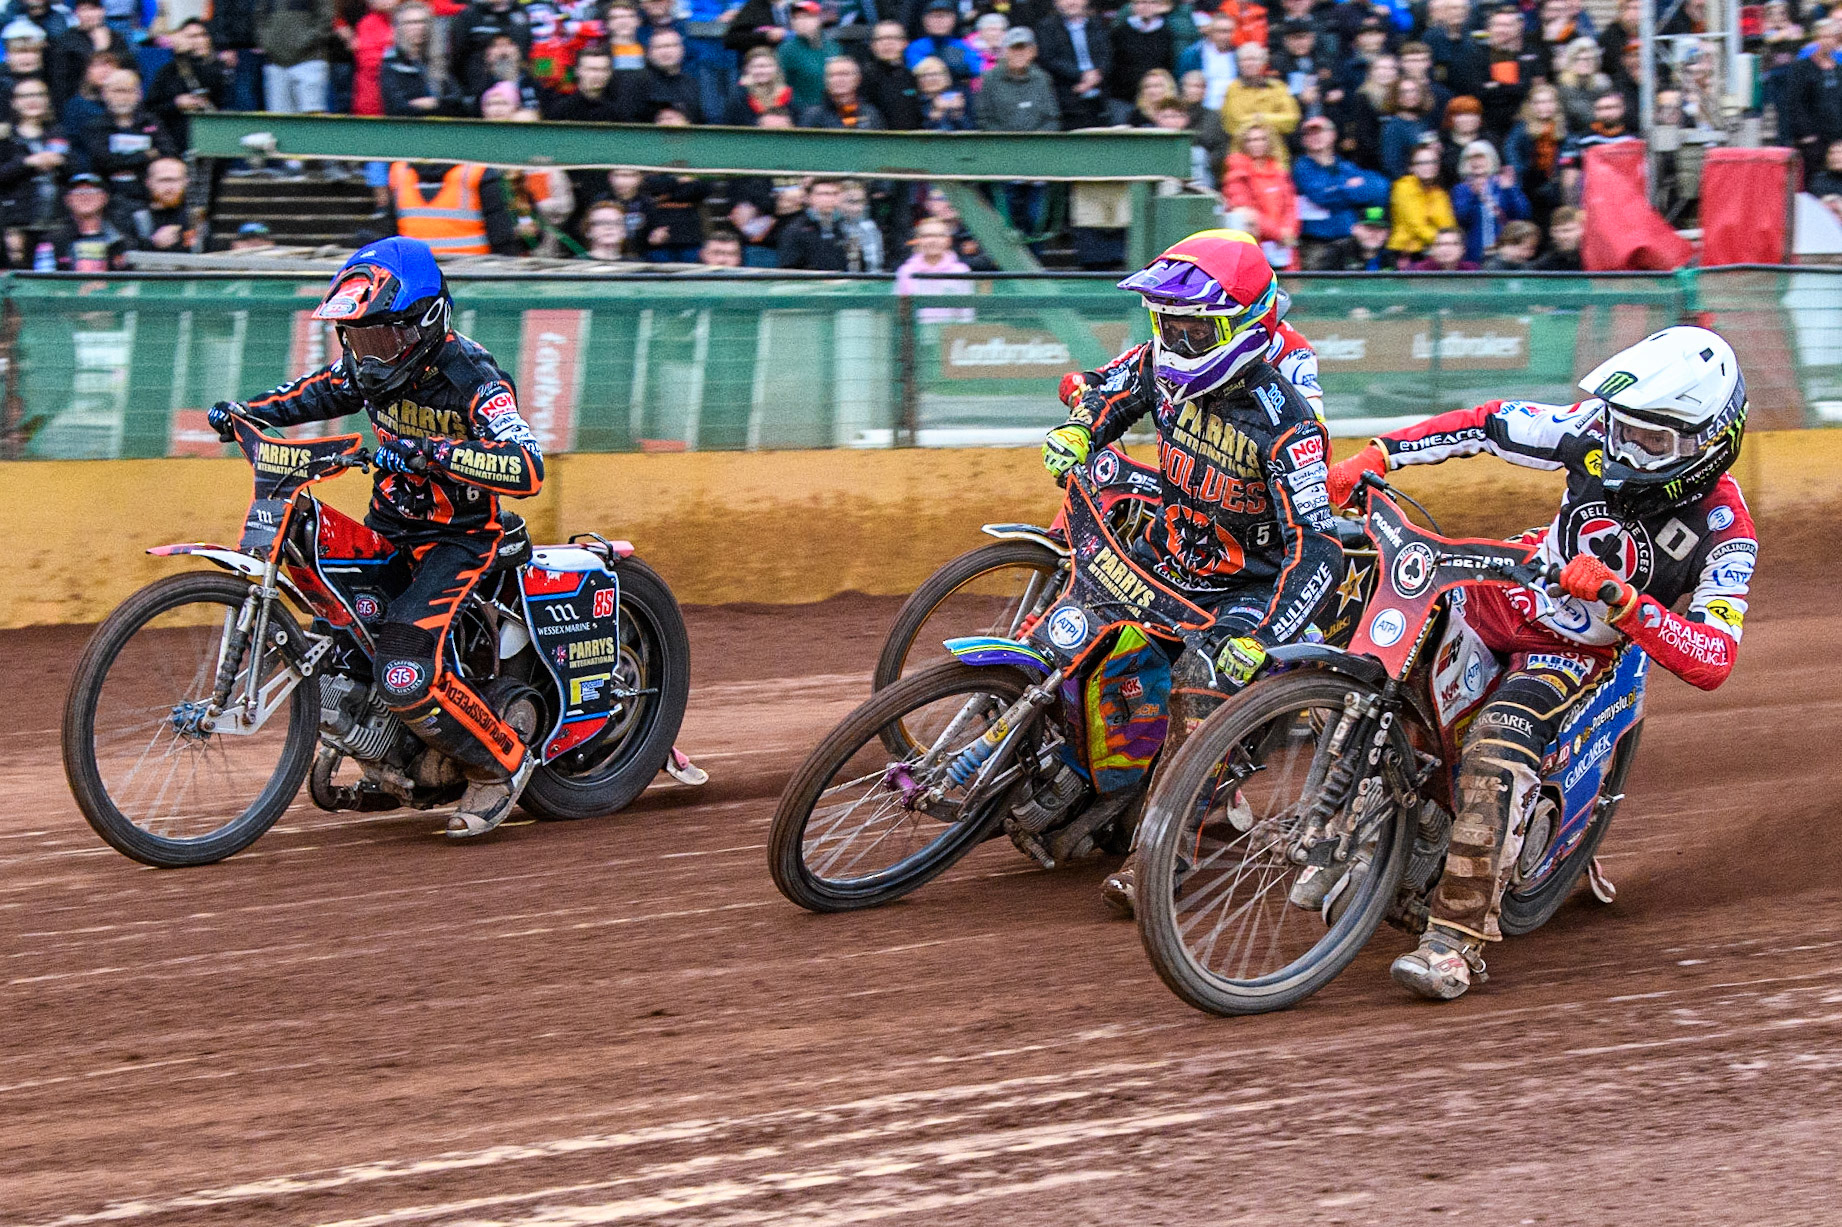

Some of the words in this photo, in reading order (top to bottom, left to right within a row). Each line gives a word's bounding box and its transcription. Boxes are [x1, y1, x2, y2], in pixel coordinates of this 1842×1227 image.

[386, 399, 467, 435] ARRYS
[1696, 399, 1735, 446] LEATT
[258, 442, 312, 467] PARRYS
[451, 448, 522, 475] PARRYS
[1291, 437, 1323, 461] NGK
[450, 462, 521, 483] INTERNATIONAL
[466, 486, 480, 501] 6
[1256, 525, 1271, 545] 5
[1580, 506, 1609, 520] BELL
[1637, 541, 1650, 574] ACES
[1093, 546, 1155, 609] PARRYS
[593, 588, 615, 618] 85
[1271, 561, 1331, 637] BULLSEYE
[1057, 617, 1079, 639] ATPI
[1376, 619, 1399, 635] ATPI
[569, 636, 615, 661] PARRYS
[569, 655, 615, 669] INTERNATIONAL
[391, 668, 411, 684] STS
